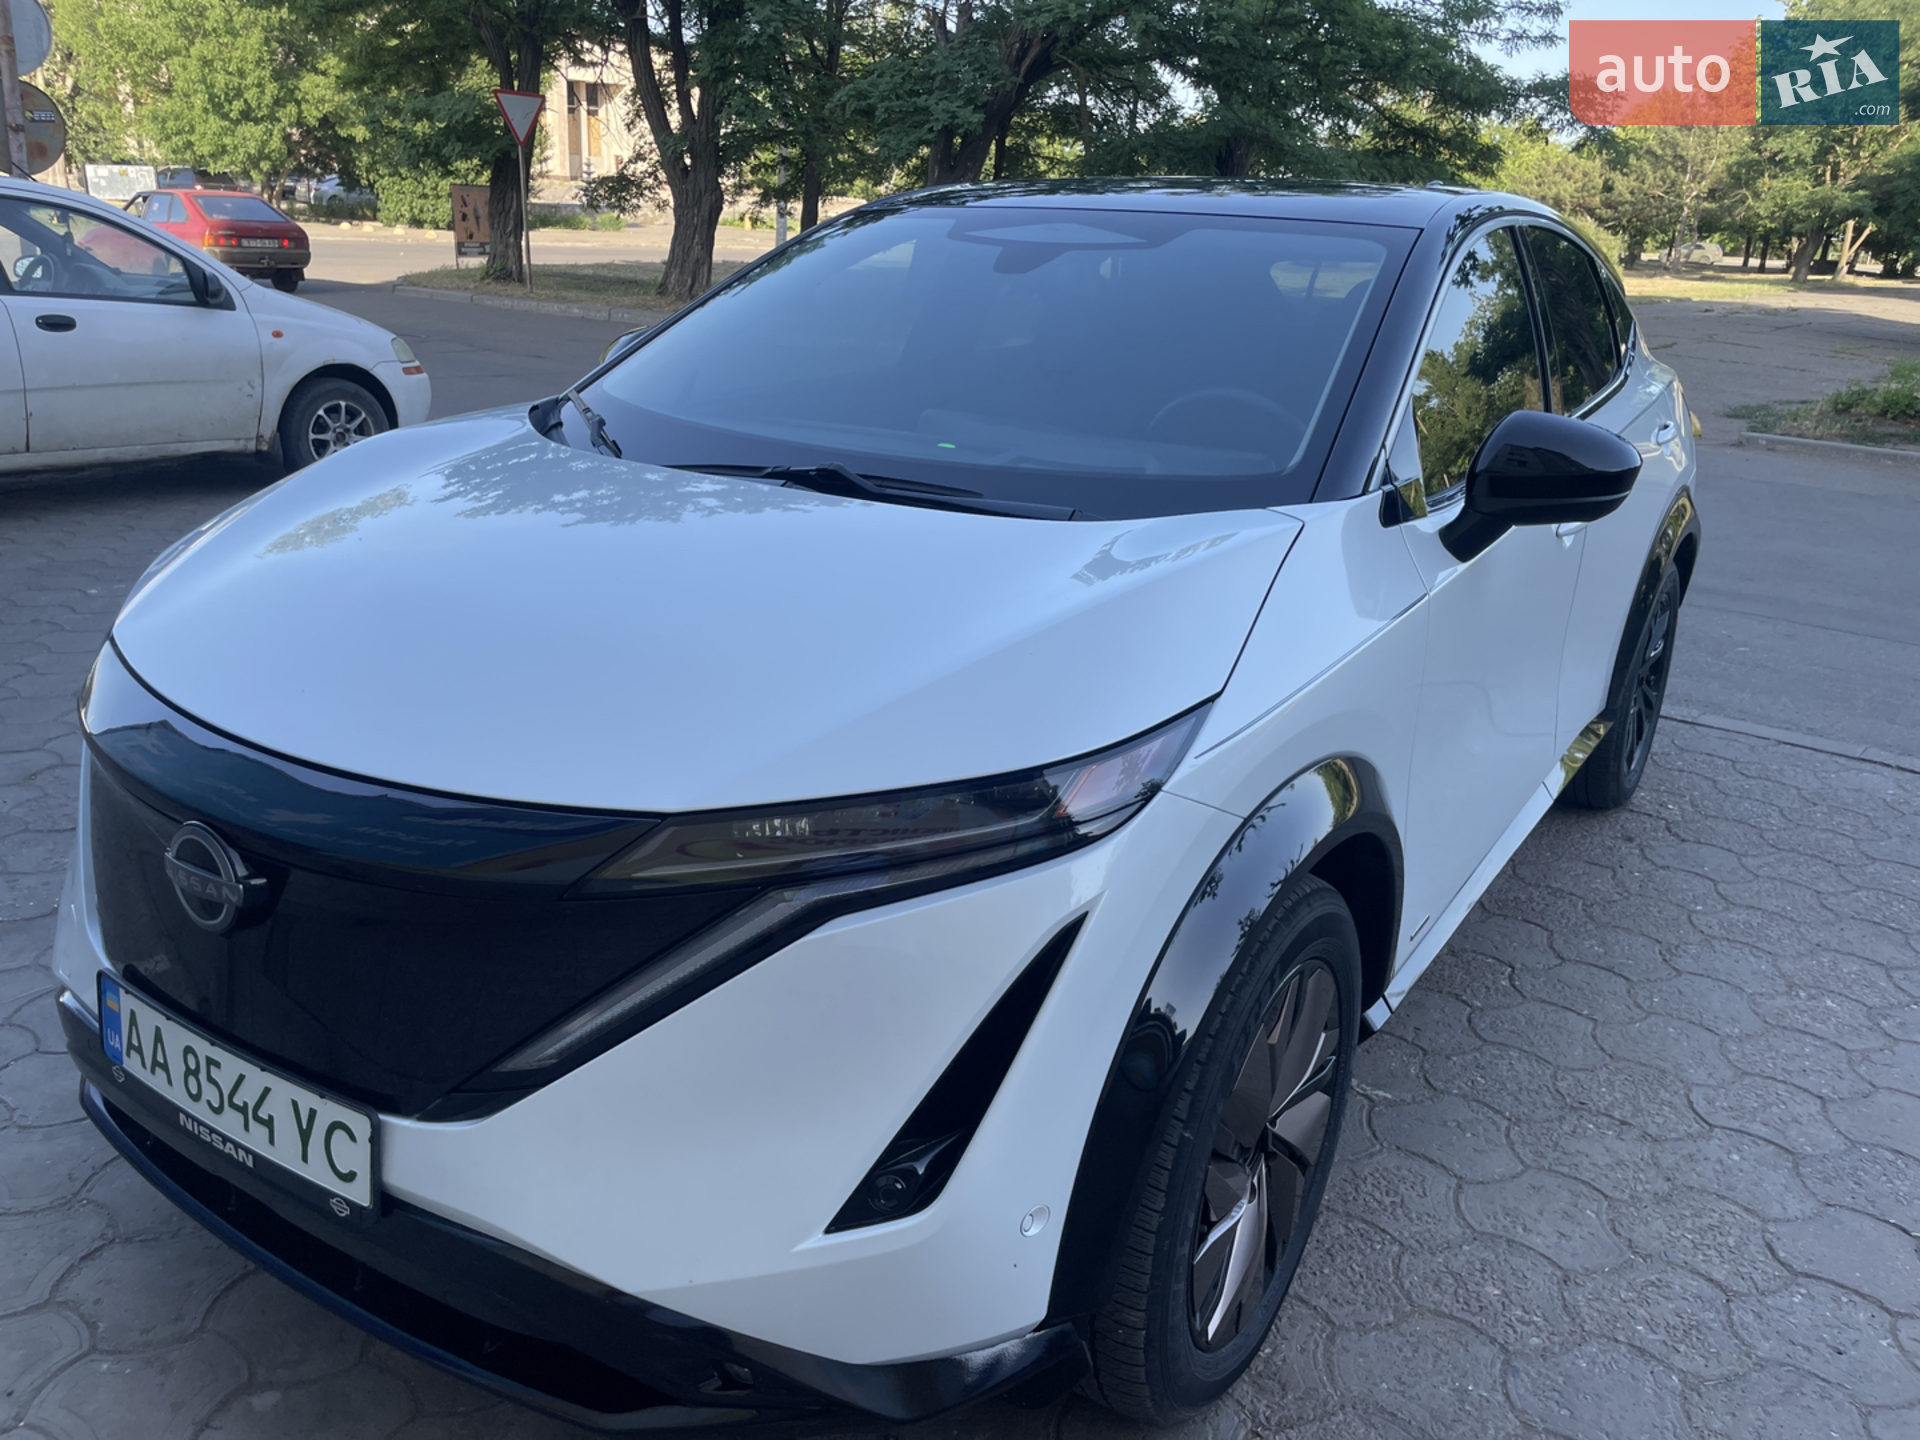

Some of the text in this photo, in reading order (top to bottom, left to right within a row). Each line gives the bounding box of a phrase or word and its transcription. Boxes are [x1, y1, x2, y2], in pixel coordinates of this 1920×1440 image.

[107, 1027, 122, 1051] UA
[125, 1008, 358, 1184] AA 8544 YC
[178, 1111, 255, 1168] NISSAN
